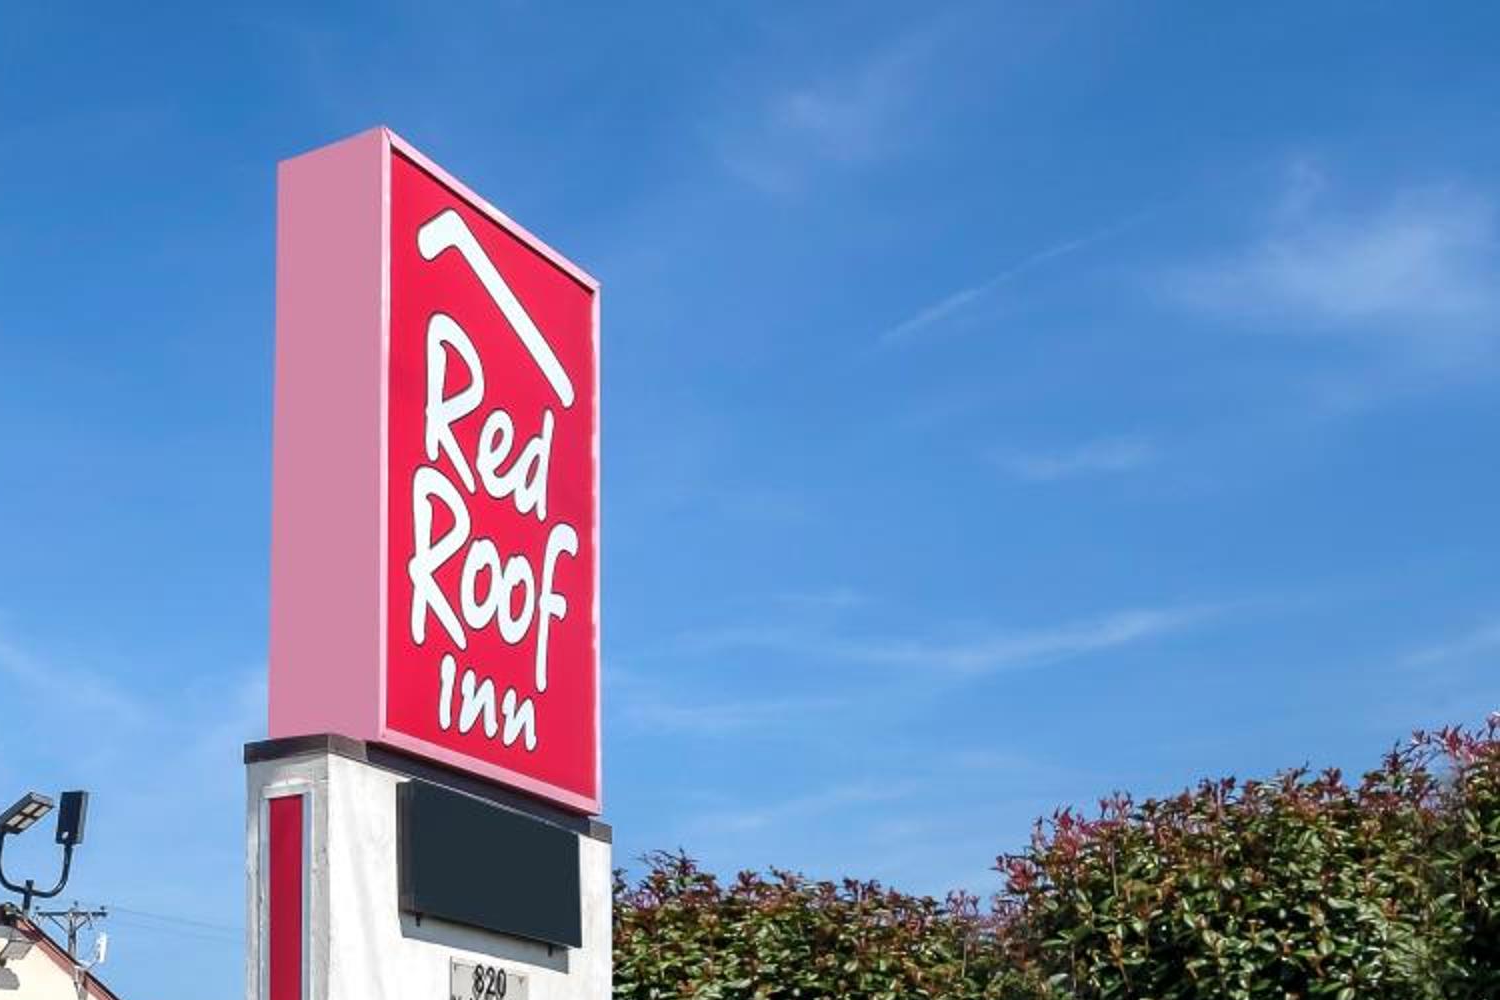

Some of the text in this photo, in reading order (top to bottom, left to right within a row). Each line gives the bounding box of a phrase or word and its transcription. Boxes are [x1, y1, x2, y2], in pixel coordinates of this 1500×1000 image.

[425, 312, 554, 521] Red
[407, 465, 578, 693] Roof
[474, 964, 507, 998] 820
